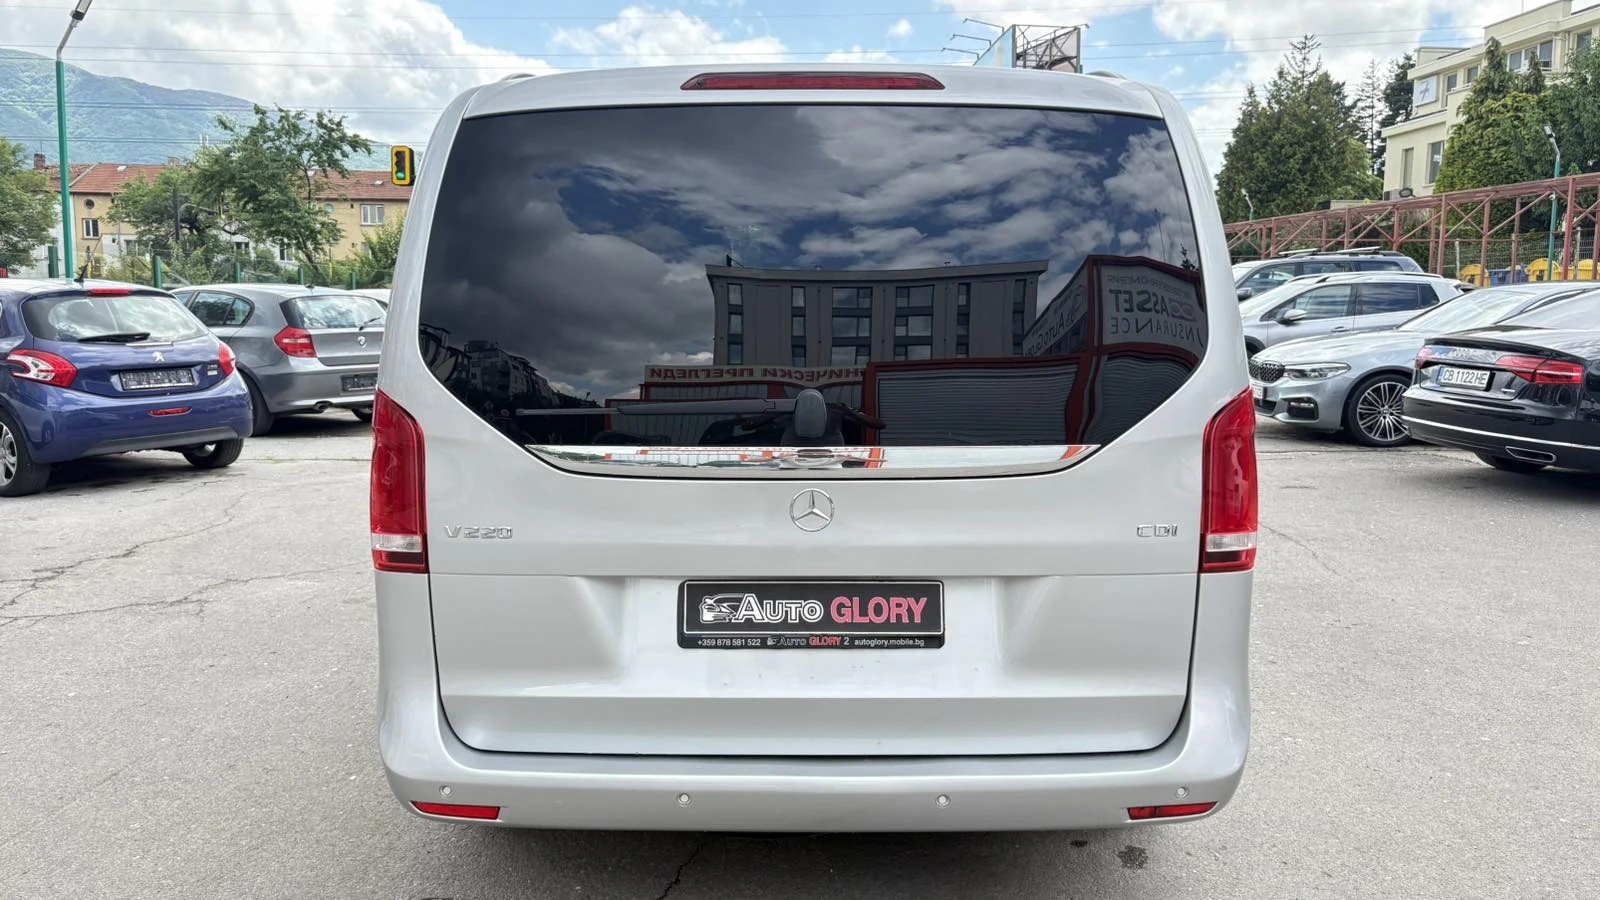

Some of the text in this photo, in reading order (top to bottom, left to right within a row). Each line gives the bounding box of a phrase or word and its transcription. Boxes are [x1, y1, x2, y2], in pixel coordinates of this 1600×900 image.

[1455, 370, 1475, 383] 1122
[443, 525, 513, 539] V220
[1136, 524, 1178, 537] CDI
[830, 596, 927, 623] GLORY
[716, 638, 731, 646] 878
[732, 638, 745, 646] 581
[747, 638, 761, 646] 522
[808, 636, 842, 646] GLORY
[843, 636, 850, 646] 2
[854, 638, 925, 647] autoglory.mobile.bg
